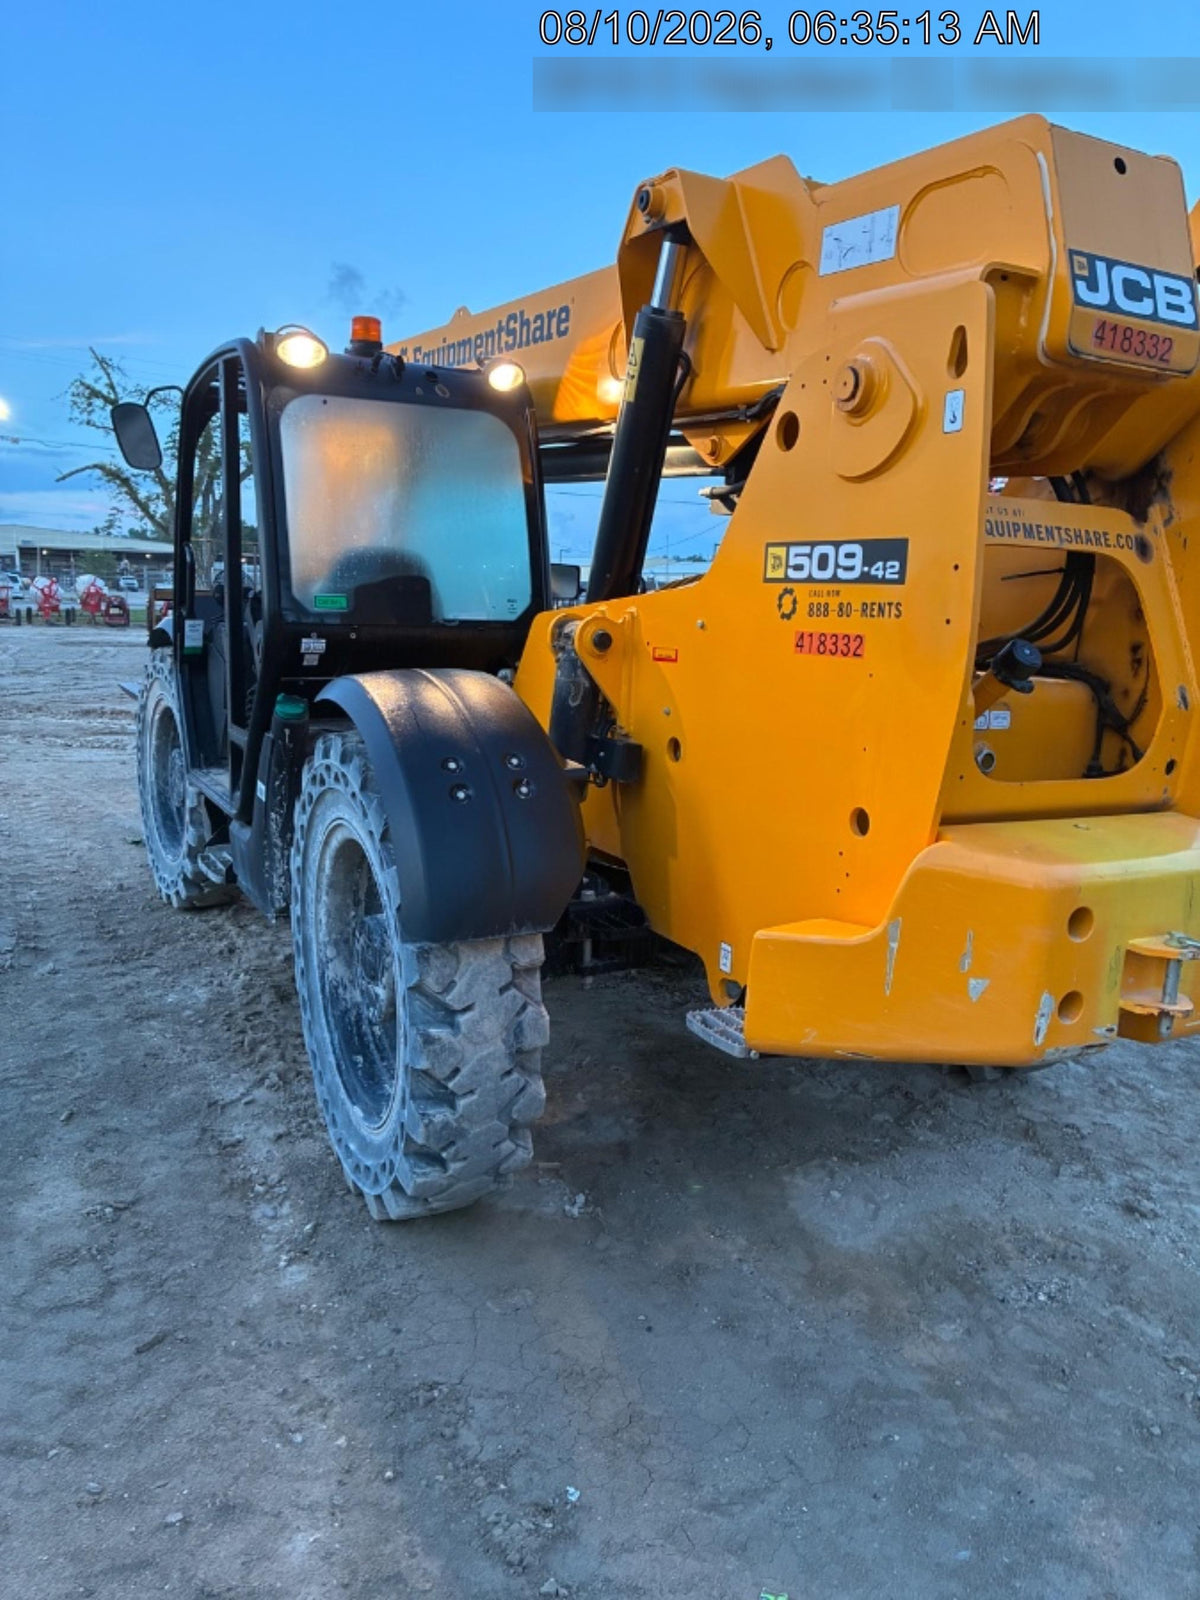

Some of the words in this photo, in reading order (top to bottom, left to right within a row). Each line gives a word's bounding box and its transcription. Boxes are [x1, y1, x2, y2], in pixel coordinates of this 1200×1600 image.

[1075, 260, 1196, 324] JCB
[1094, 319, 1173, 363] 418332
[985, 519, 1143, 552] QUIPMENTSHARE.CO
[807, 602, 903, 619] 888-80-RENTS
[796, 632, 864, 657] 418332
